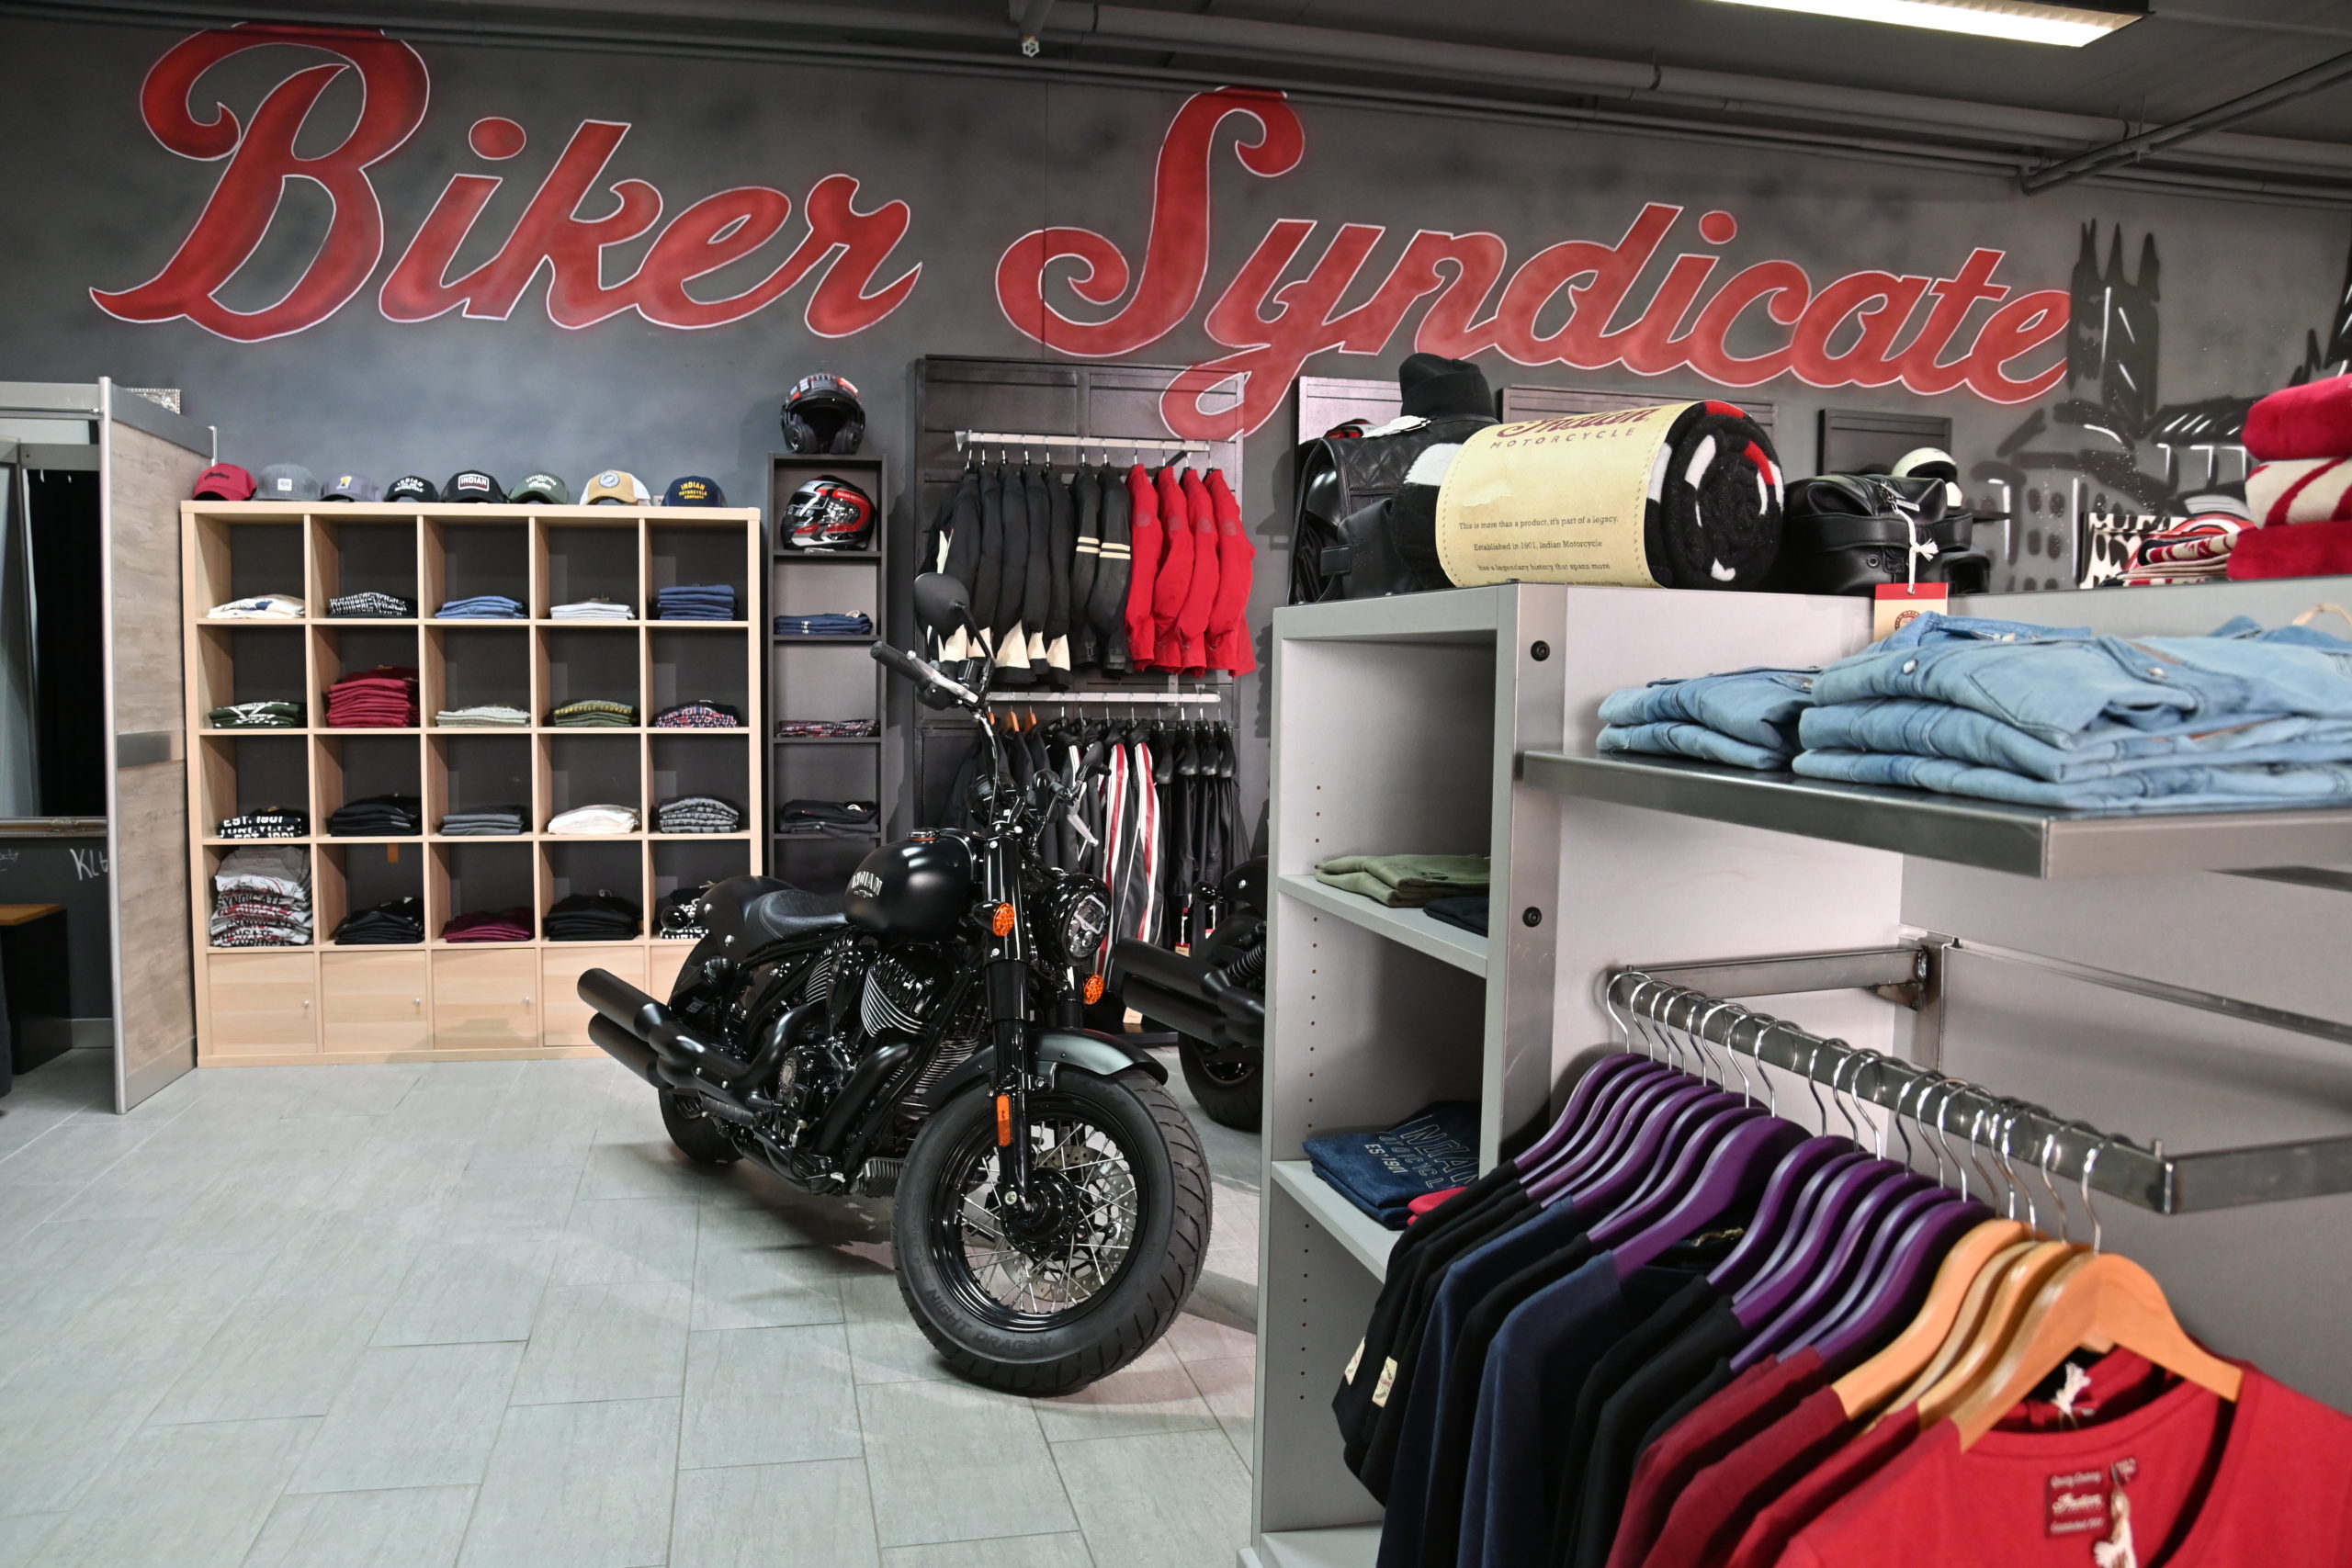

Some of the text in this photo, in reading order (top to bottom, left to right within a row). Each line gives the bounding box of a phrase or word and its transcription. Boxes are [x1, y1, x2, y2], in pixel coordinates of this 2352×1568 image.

[89, 22, 2071, 438] Biker Syndicate
[1497, 408, 1661, 437] Indian
[1490, 426, 1635, 449] MOTORCYCLE
[460, 476, 487, 485] INDIAN
[681, 481, 706, 491] INDIAN
[1459, 522, 1473, 530] This
[1498, 520, 1513, 528] than
[1550, 517, 1560, 525] it's
[1561, 517, 1577, 526] part
[1577, 516, 1585, 525] of
[1592, 515, 1619, 525] legacy.
[1474, 543, 1511, 551] Established
[1539, 540, 1562, 548] Indian
[1562, 539, 1603, 548] Motorcycle
[1529, 563, 1554, 571] history
[853, 871, 883, 897] INDIAN
[925, 1289, 972, 1331] NIGHT
